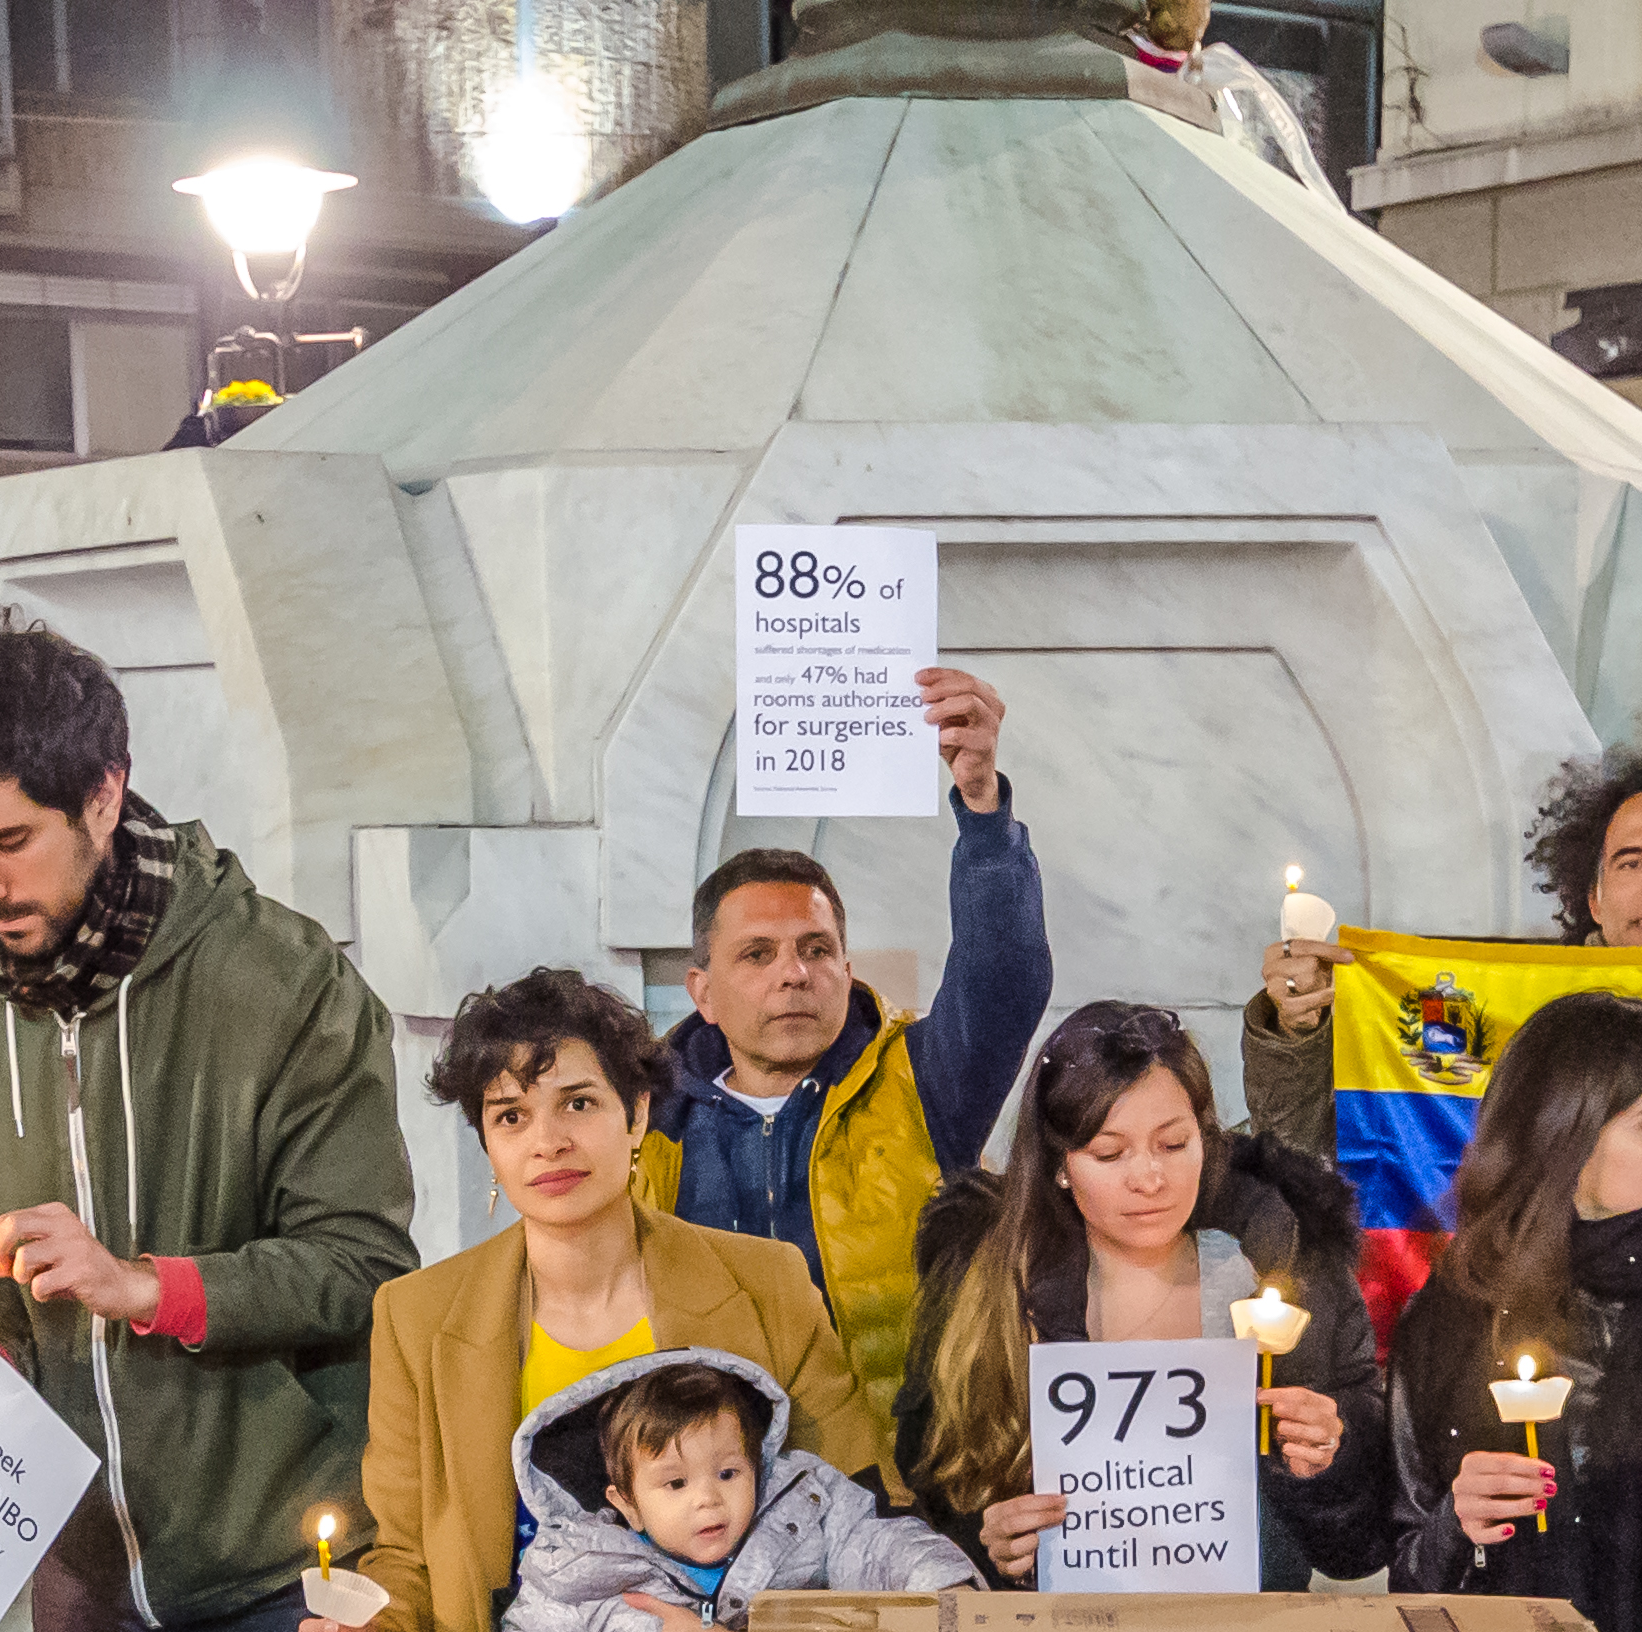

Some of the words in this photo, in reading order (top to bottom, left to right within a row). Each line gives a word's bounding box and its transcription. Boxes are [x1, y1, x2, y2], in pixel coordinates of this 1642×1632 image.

[755, 550, 866, 599] 88%
[879, 578, 904, 600] of
[755, 611, 861, 639] hospitals
[801, 666, 848, 685] 47%
[854, 666, 888, 685] had
[754, 694, 815, 708] rooms
[754, 713, 789, 736] for
[797, 715, 914, 743] surgeries.
[755, 750, 776, 771] in
[785, 749, 846, 772] 2018
[1048, 1367, 1207, 1447] 973
[1059, 1454, 1193, 1496] political
[1061, 1499, 1226, 1540] prisoners
[1063, 1537, 1137, 1569] until
[1152, 1539, 1229, 1567] now
